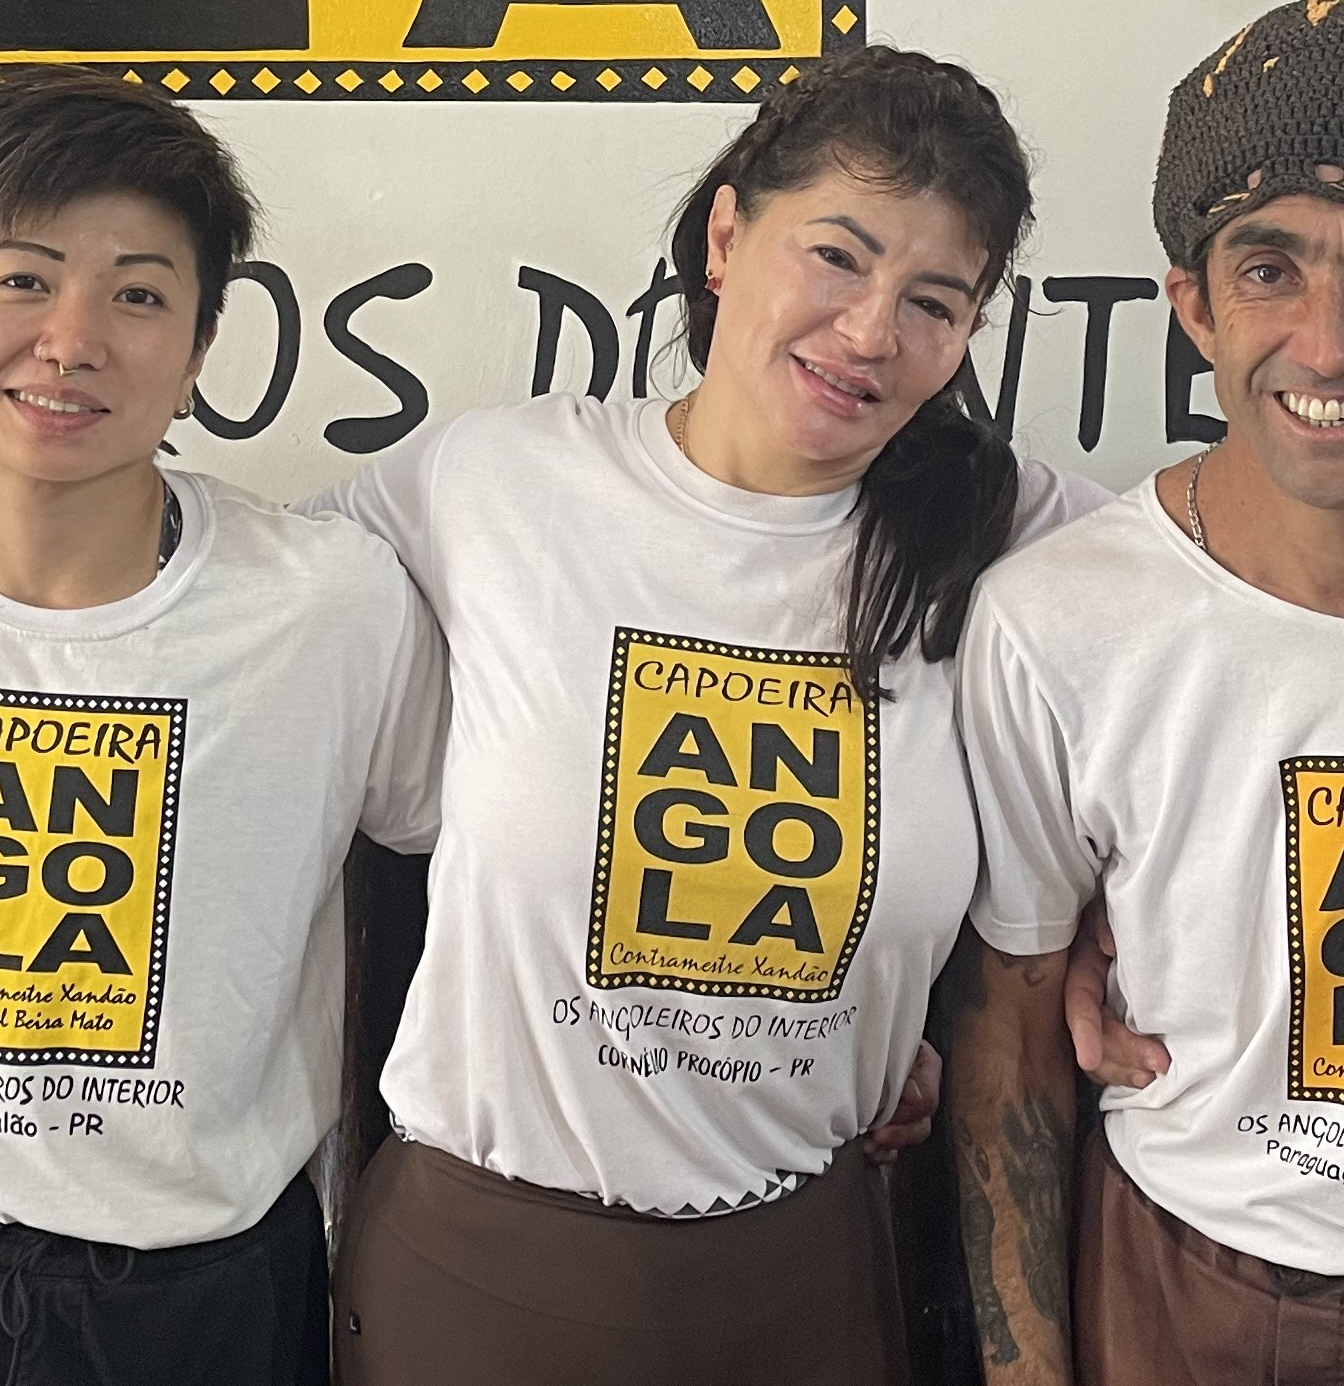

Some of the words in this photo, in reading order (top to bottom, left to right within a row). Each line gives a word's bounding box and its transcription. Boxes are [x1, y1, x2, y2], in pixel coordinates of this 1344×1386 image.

[634, 660, 853, 718] CAPOEIRA
[637, 712, 840, 800] AN
[633, 787, 843, 879] GO
[635, 868, 824, 954] LA
[610, 942, 744, 975] Contramestre
[752, 954, 829, 983] Xandão
[61, 984, 137, 1005] Xandão
[14, 1009, 64, 1030] Beira
[70, 1011, 114, 1031] Mato
[553, 996, 581, 1025] OS
[589, 1000, 724, 1041] ANGOLEIROS
[732, 1015, 762, 1039] DO
[768, 1006, 857, 1040] INTERIOR
[677, 1051, 762, 1083] PROCÓPIO
[790, 1058, 815, 1077] PR
[42, 1075, 74, 1101] DO
[81, 1077, 186, 1109] INTERIOR
[69, 1113, 104, 1136] PR
[1237, 1115, 1268, 1135] OS
